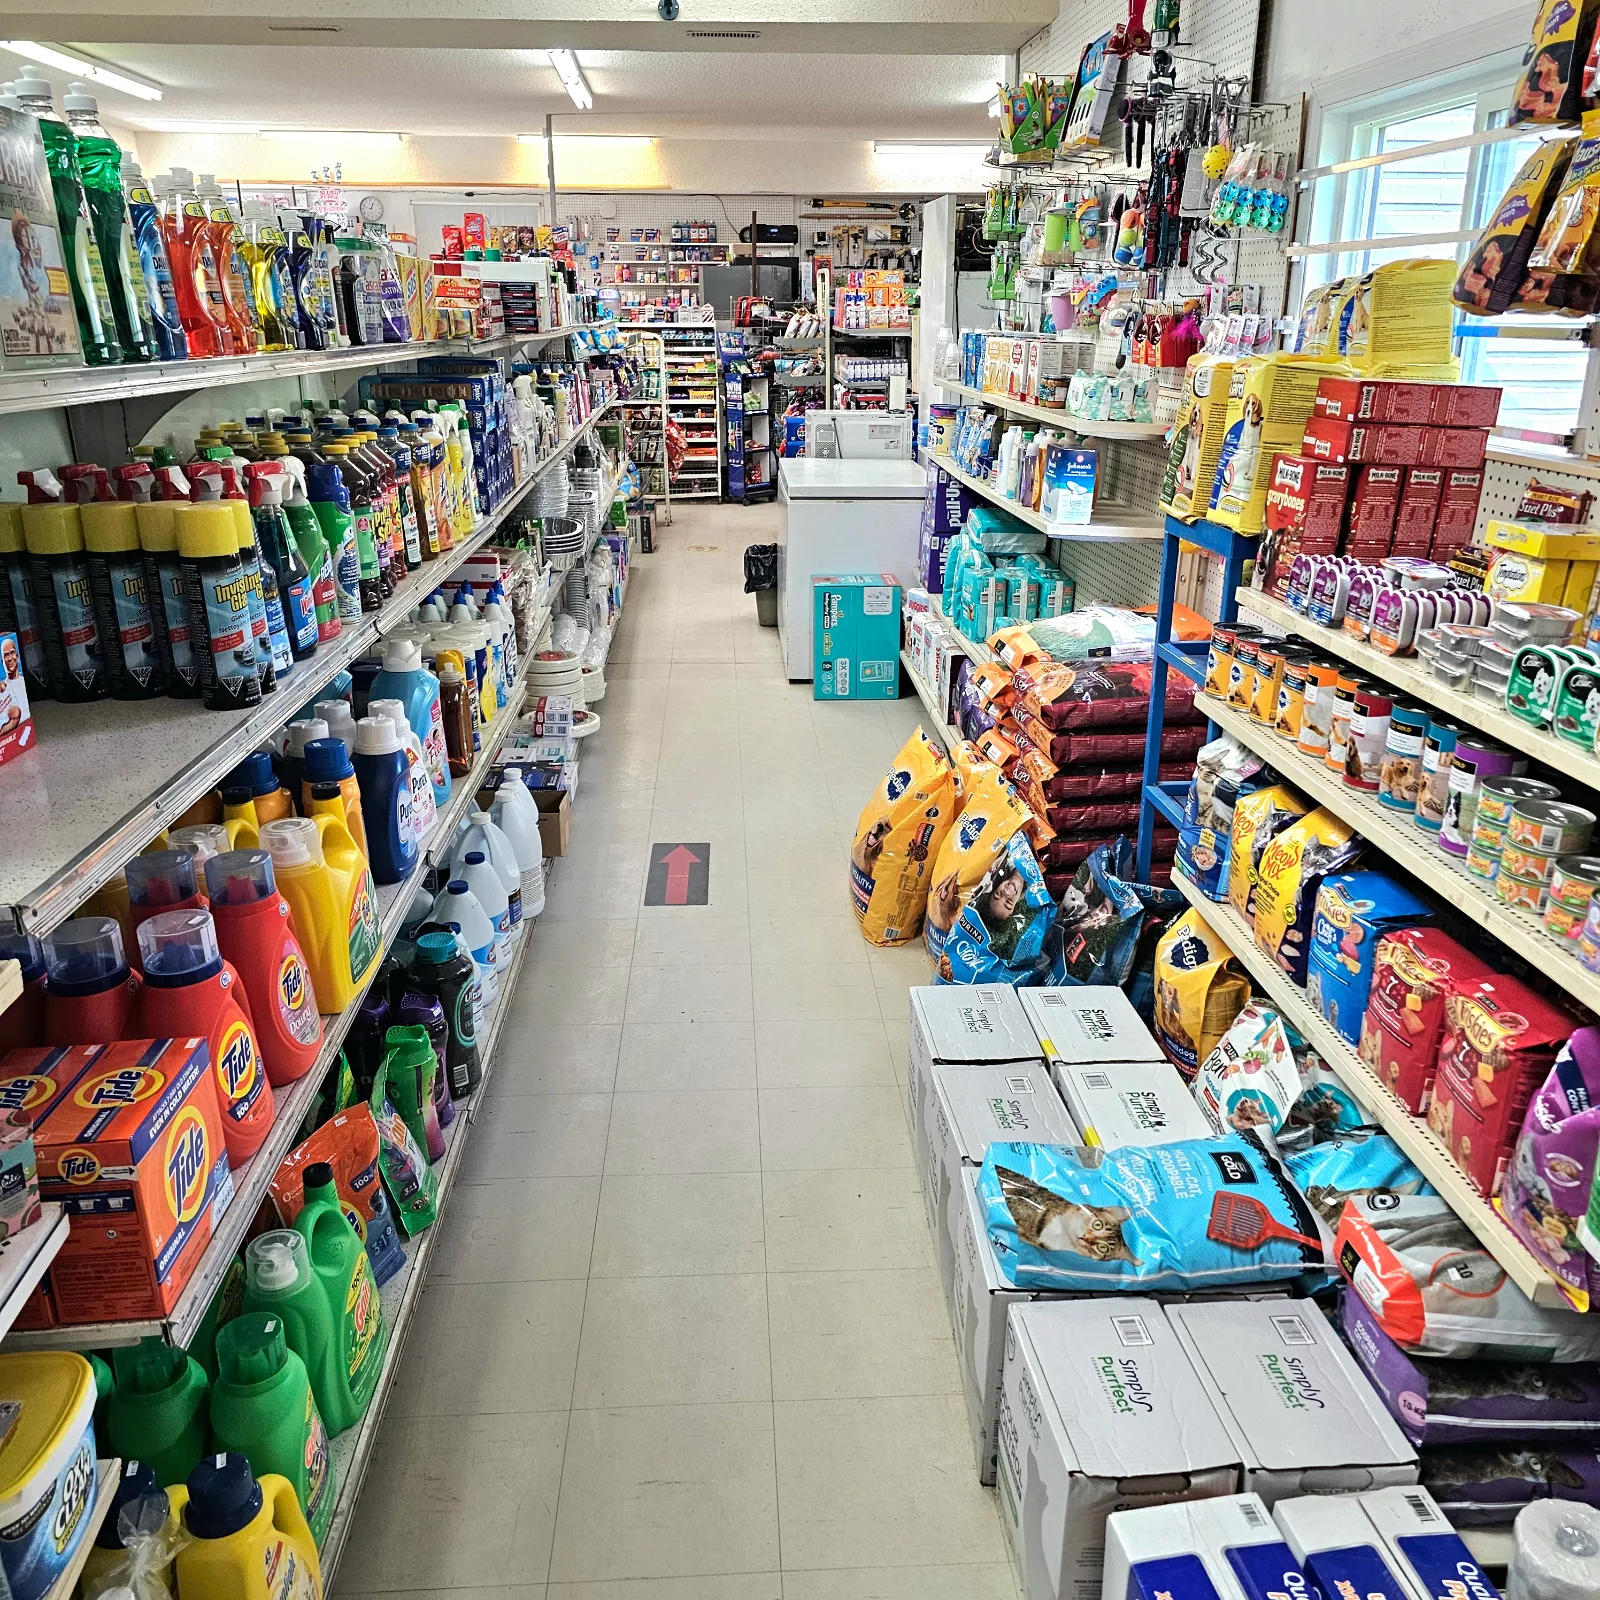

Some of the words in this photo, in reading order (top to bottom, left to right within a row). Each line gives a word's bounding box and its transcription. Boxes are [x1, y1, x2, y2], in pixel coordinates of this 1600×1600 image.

[726, 382, 742, 391] WIN
[1278, 466, 1301, 484] MILK-BONE
[1319, 469, 1346, 478] MILK-BONE
[1371, 471, 1396, 480] MILK-BONE
[1413, 473, 1439, 481] MILK-BONE
[1267, 488, 1305, 512] gravybones
[1519, 501, 1539, 515] Suet
[1541, 503, 1558, 518] Plus
[1496, 563, 1527, 582] Temptations
[831, 593, 843, 627] Pampers
[1397, 724, 1412, 733] GOLD
[1264, 840, 1299, 868] Meow
[960, 916, 984, 944] PURINA
[282, 962, 301, 1007] Tide
[289, 1007, 312, 1035] Downy
[963, 1007, 979, 1034] Purrfect
[977, 1009, 993, 1033] Simply
[1078, 1009, 1102, 1039] Purrfect
[1092, 1009, 1113, 1037] Simply
[221, 1034, 251, 1099] Tide
[91, 1069, 144, 1105] Tide
[149, 1116, 164, 1140] EVEN
[170, 1091, 183, 1110] COLD
[182, 1065, 200, 1094] WATER!
[991, 1098, 1013, 1130] Purrfect
[1007, 1100, 1029, 1129] Simply
[1126, 1091, 1154, 1130] Purrfect
[1141, 1091, 1164, 1124] Simply
[61, 1157, 97, 1180] Tide
[168, 1122, 205, 1223] Tide
[1220, 1155, 1241, 1180] GOLD
[159, 1227, 186, 1270] ORIGINAL
[1097, 1356, 1133, 1413] Purrfect
[1118, 1358, 1153, 1413] Simply
[1262, 1354, 1305, 1409] Purrfect
[1283, 1356, 1325, 1409] Simply
